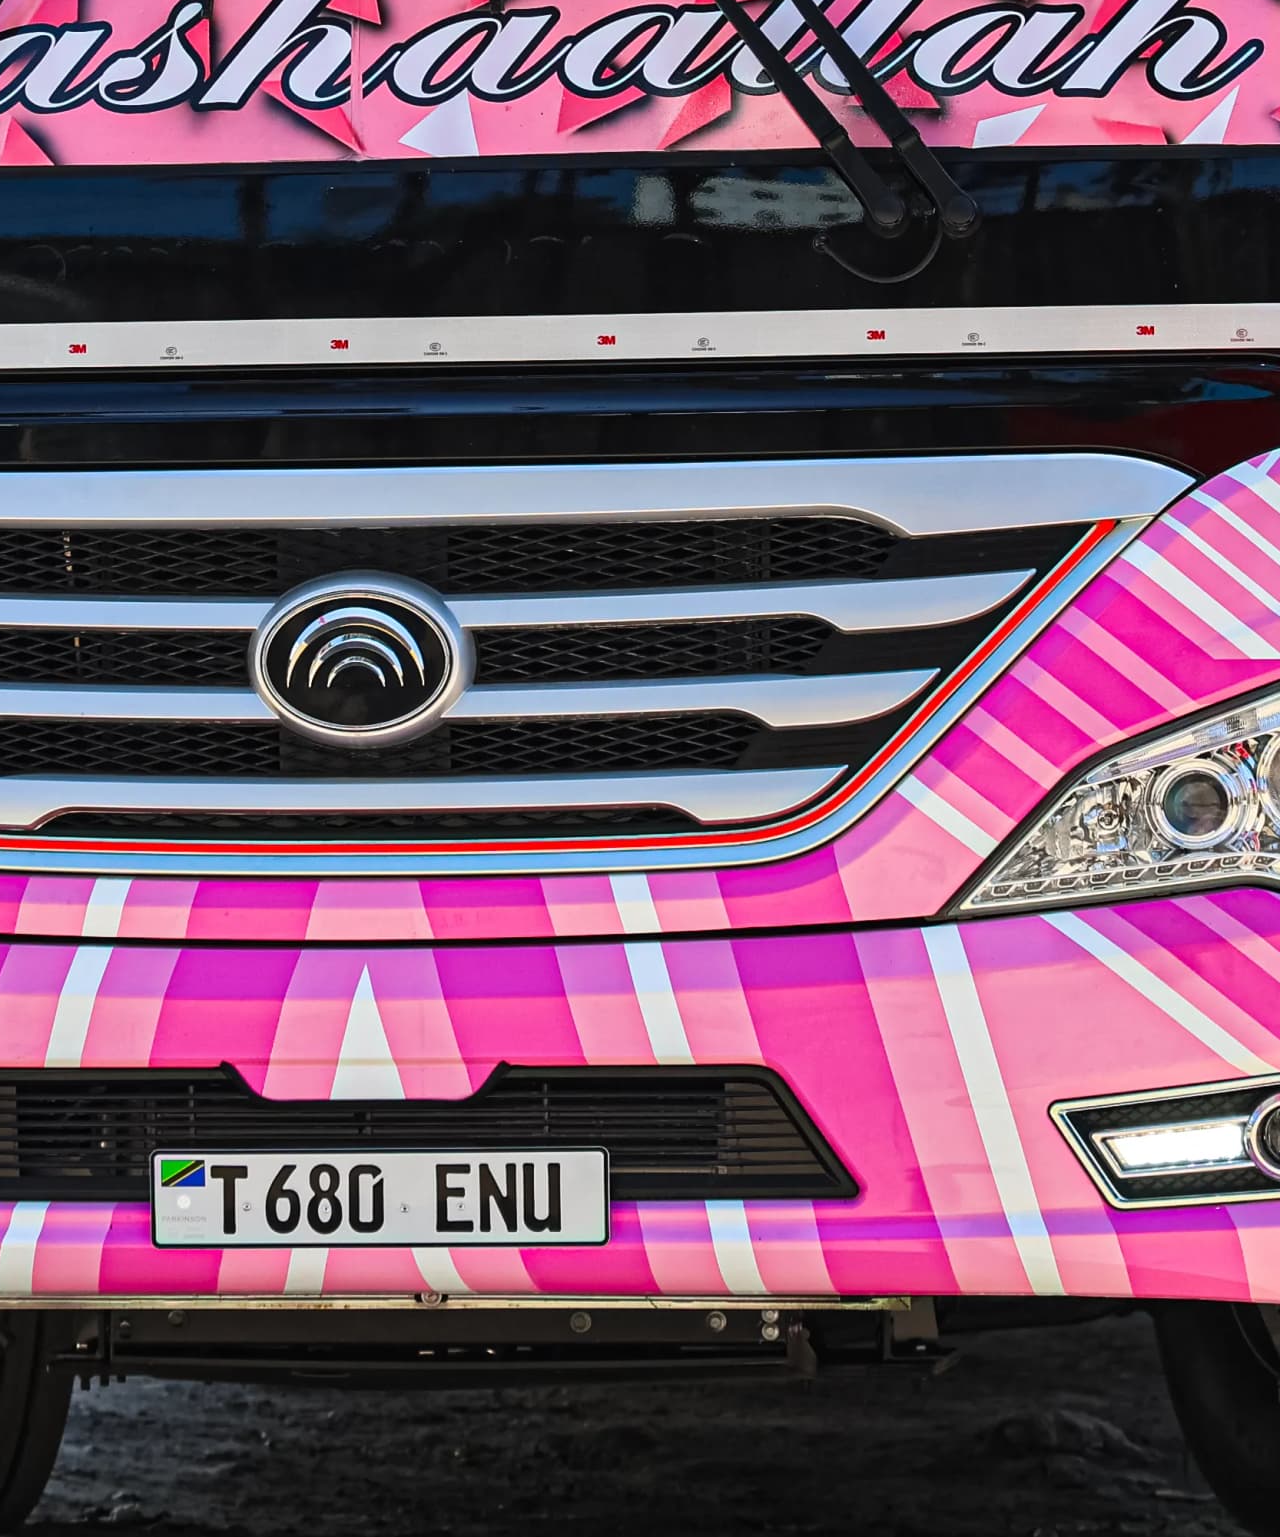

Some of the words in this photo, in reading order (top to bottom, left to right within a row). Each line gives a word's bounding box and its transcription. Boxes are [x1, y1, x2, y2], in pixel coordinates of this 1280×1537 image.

[69, 344, 87, 354] 3M
[330, 339, 350, 350] 3M
[597, 335, 617, 346] 3M
[866, 330, 886, 341] 3M
[1136, 325, 1156, 336] 3M
[435, 1162, 562, 1233] ENU
